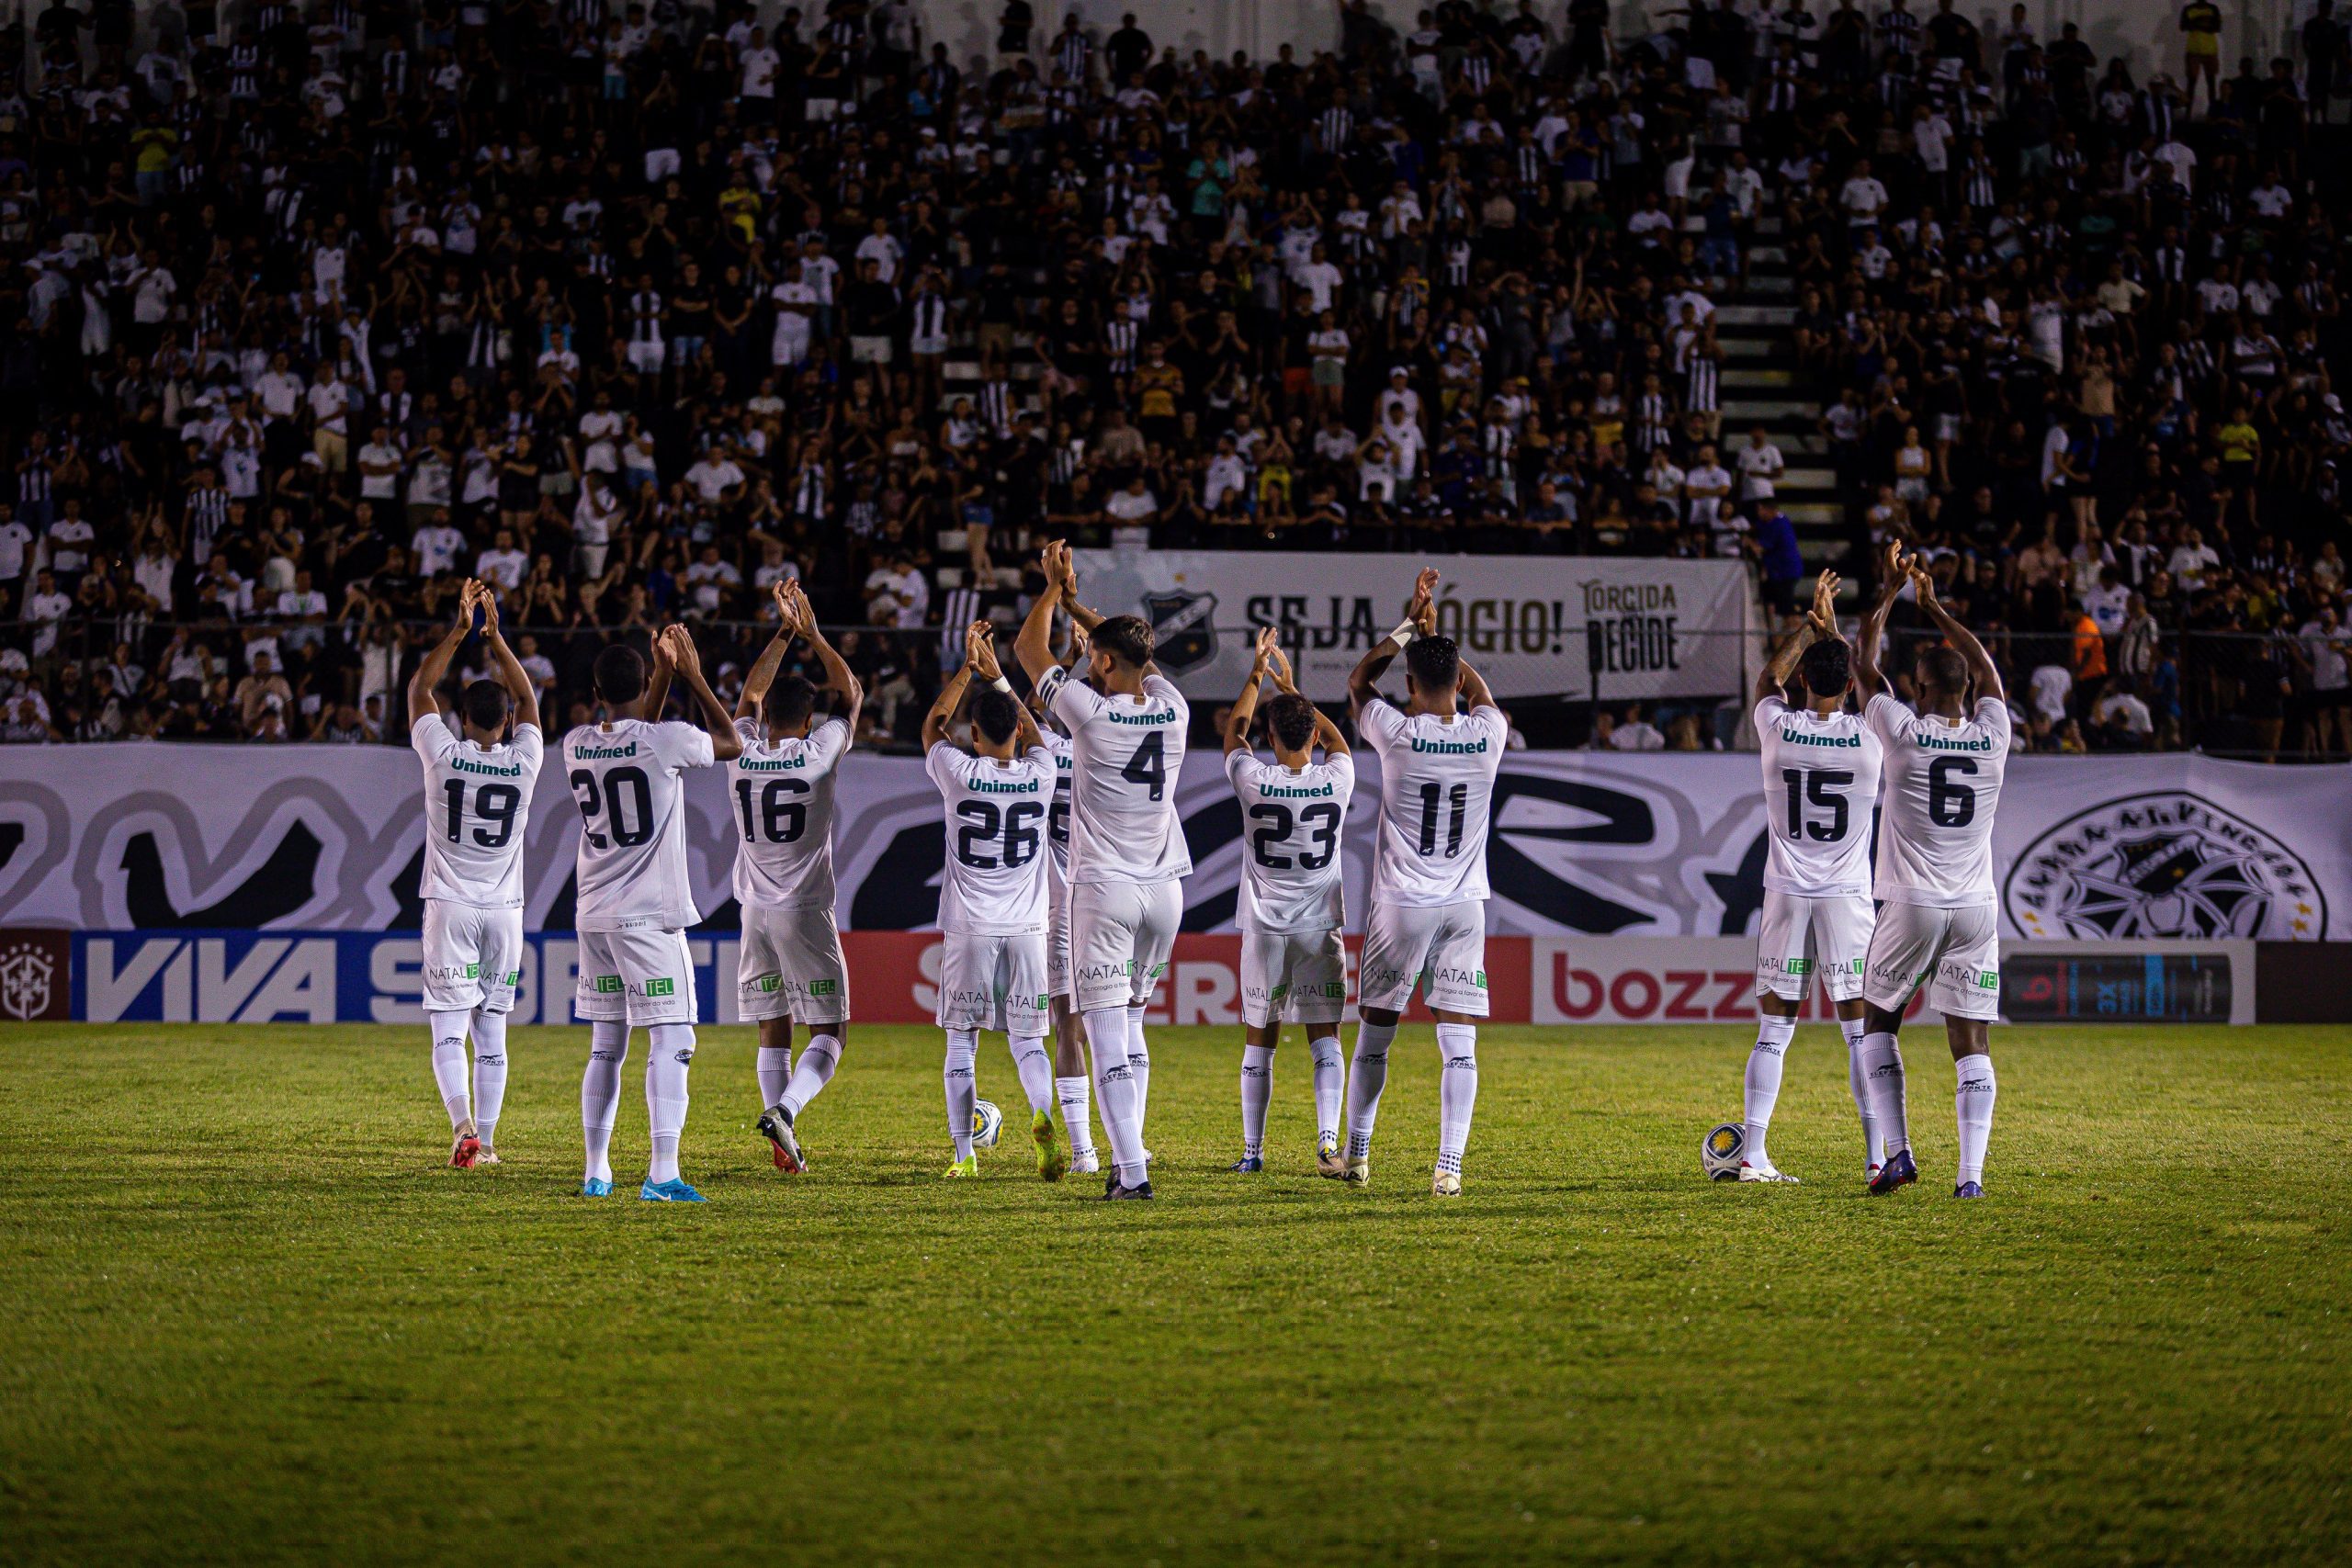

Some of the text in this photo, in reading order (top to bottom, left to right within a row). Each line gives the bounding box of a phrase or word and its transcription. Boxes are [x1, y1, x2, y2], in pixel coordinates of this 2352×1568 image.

[1246, 596, 1376, 649] SEJA
[1108, 707, 1176, 726] Unimed
[1411, 737, 1487, 754] Unimed
[1782, 728, 1861, 747] Unimed
[1917, 733, 1992, 751] Unimed
[451, 757, 521, 777] Unimed
[574, 740, 637, 760] Unimed
[739, 754, 806, 771] Unimed
[1121, 730, 1166, 802] 4
[444, 778, 521, 848] 19
[570, 765, 655, 850] 20
[735, 778, 810, 843] 16
[968, 778, 1038, 793] Unimed
[1260, 782, 1334, 797] Unimed
[1781, 768, 1855, 842] 15
[1928, 755, 1979, 828] 6
[956, 799, 1046, 869] 26
[1249, 802, 1342, 870] 23
[1419, 783, 1468, 859] 11
[87, 938, 337, 1023] VIVA
